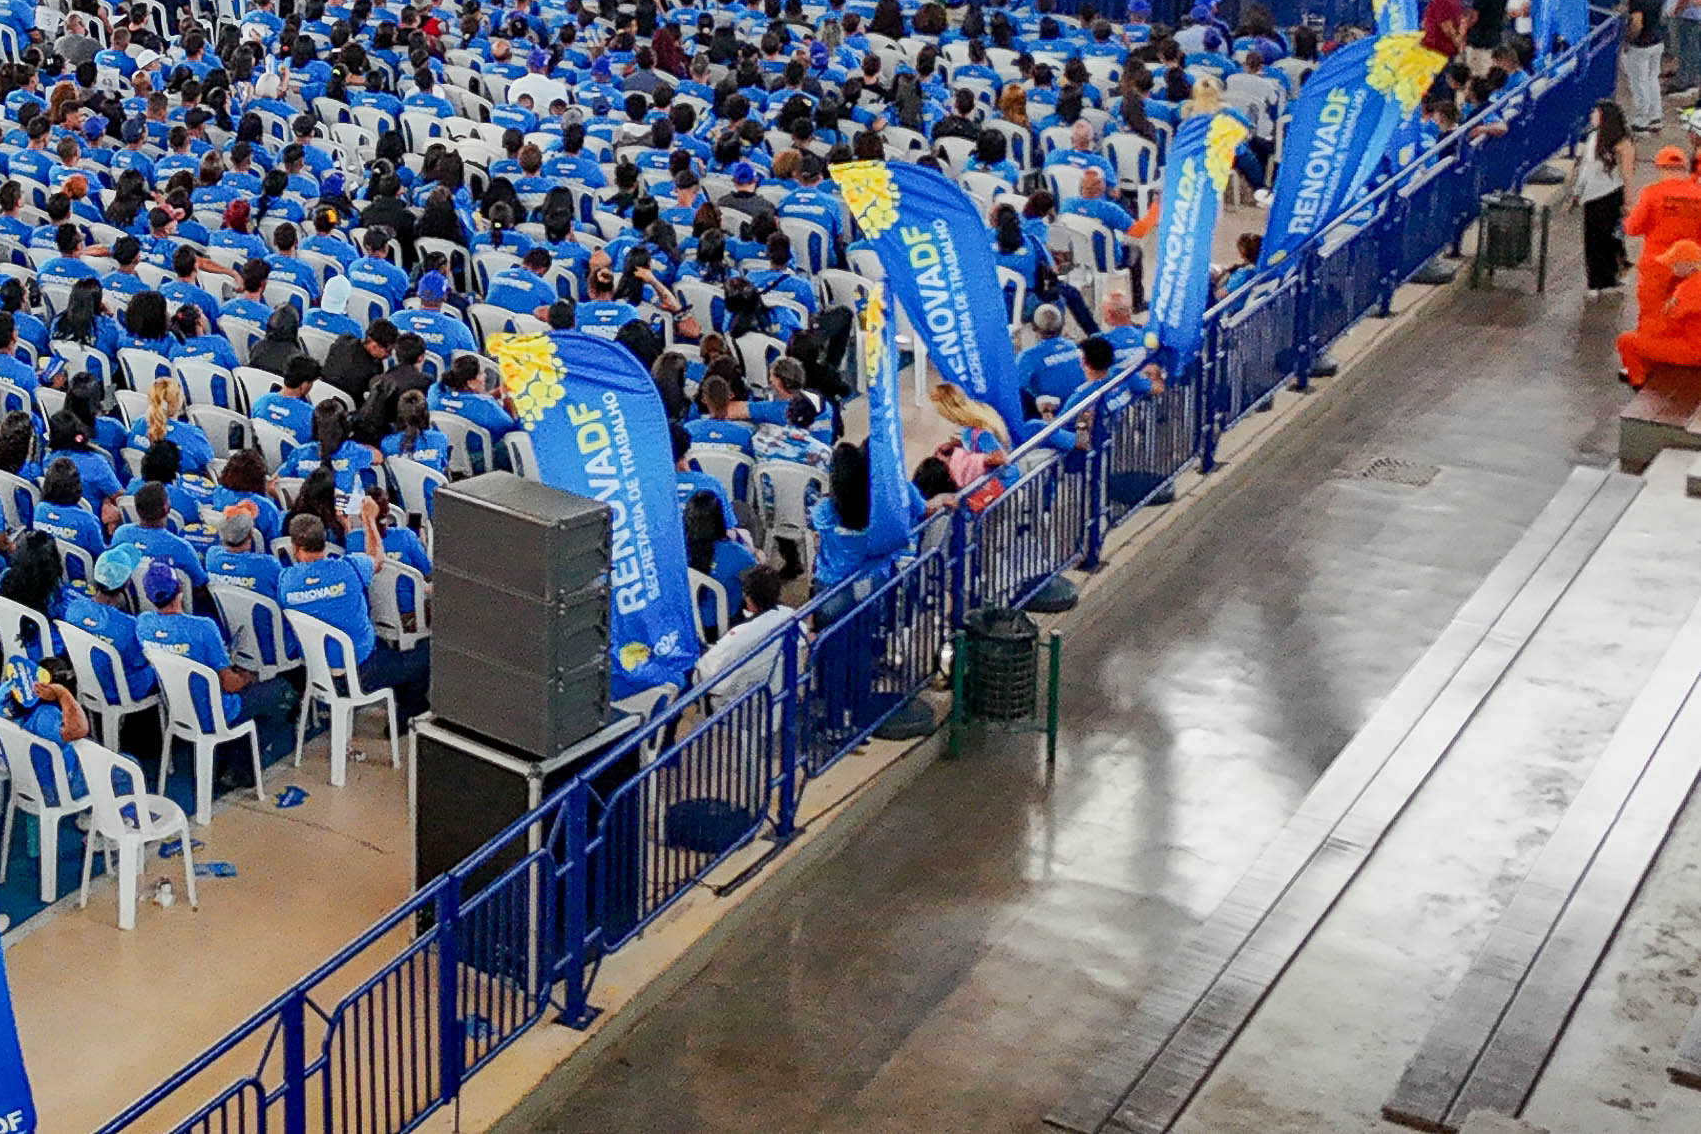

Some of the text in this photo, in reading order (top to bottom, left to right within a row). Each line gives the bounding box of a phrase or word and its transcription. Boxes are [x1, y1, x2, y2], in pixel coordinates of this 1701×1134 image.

[900, 226, 968, 383] ENOVADF
[601, 391, 635, 477] TRABALHO
[626, 479, 642, 501] DE
